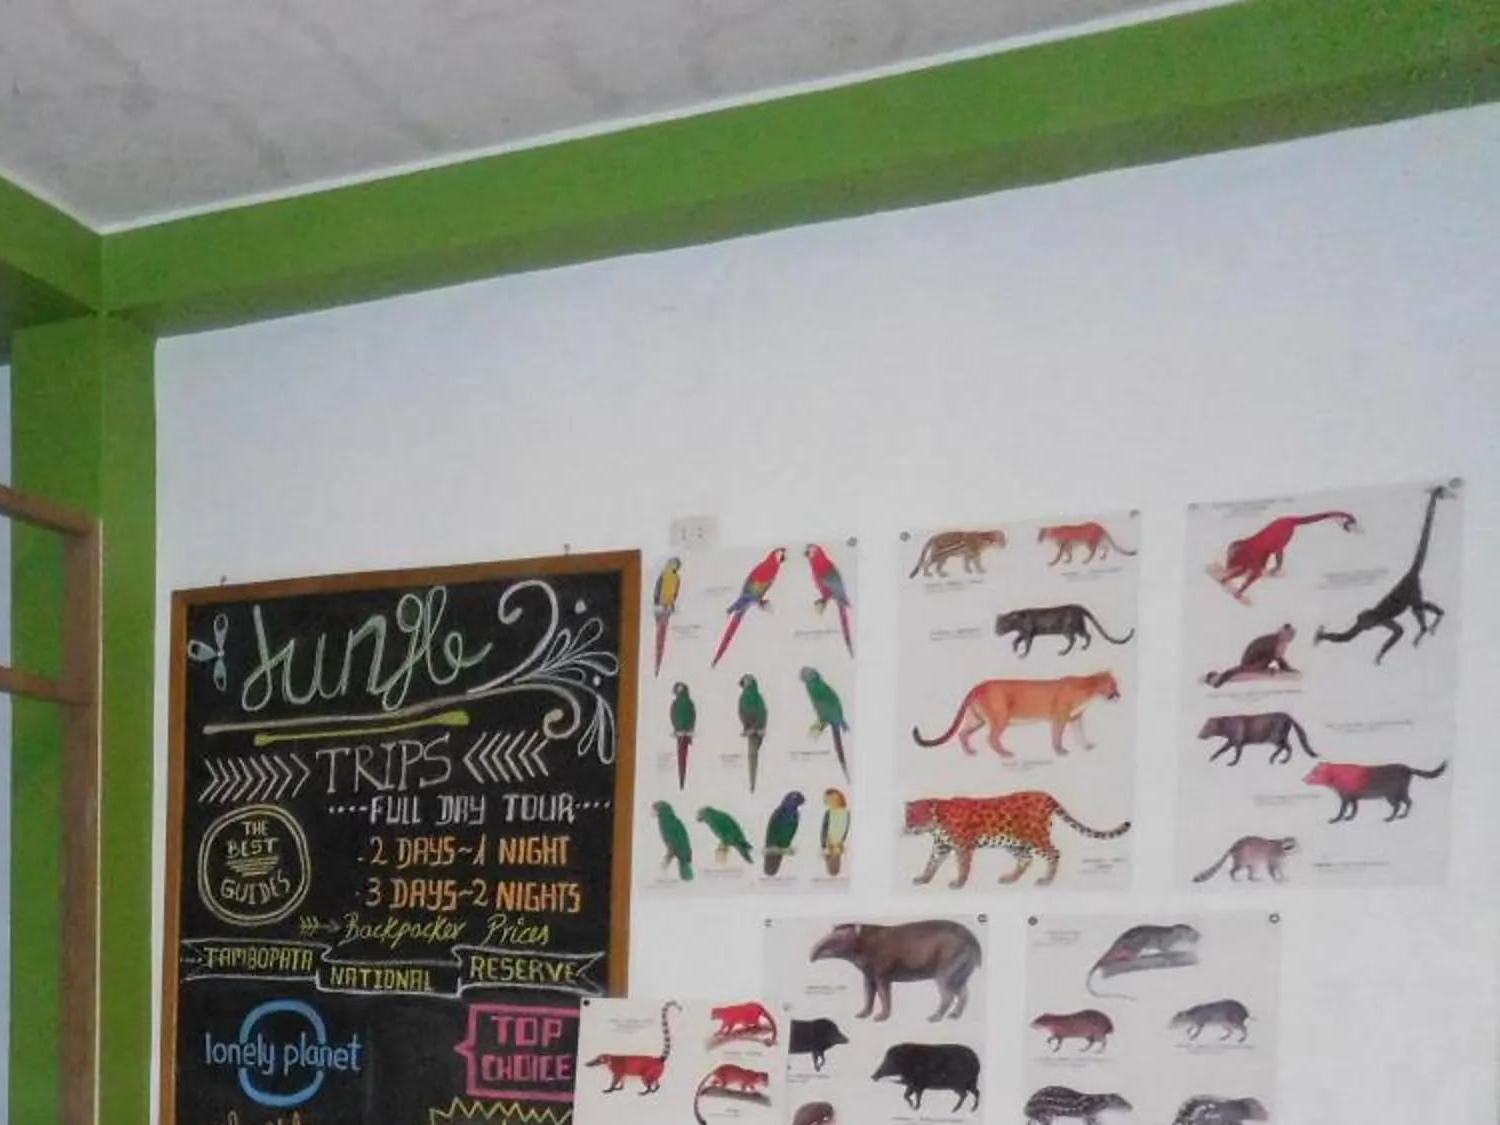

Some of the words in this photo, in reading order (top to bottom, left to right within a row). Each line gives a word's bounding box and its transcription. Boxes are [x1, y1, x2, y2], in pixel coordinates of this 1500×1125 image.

[241, 585, 494, 712] Jungle
[315, 732, 453, 794] TRIPS
[369, 795, 422, 826] FULL
[435, 794, 487, 826] DAY
[502, 792, 577, 825] TOUR
[240, 820, 270, 837] THE
[226, 837, 280, 859] BEST
[369, 835, 388, 865] 2
[498, 834, 573, 866] NIGHT
[220, 868, 291, 905] GUIDES
[364, 877, 382, 907] 3
[495, 880, 581, 913] NIGHTS
[481, 913, 550, 947] Prices
[205, 945, 314, 973] TAMBOPATA
[330, 965, 433, 993] NATIONAL
[469, 955, 579, 984] RESERVE
[491, 1016, 563, 1048] TOP
[205, 1033, 276, 1074] lonely
[283, 1039, 363, 1073] planet
[481, 1052, 573, 1082] CHOICE
